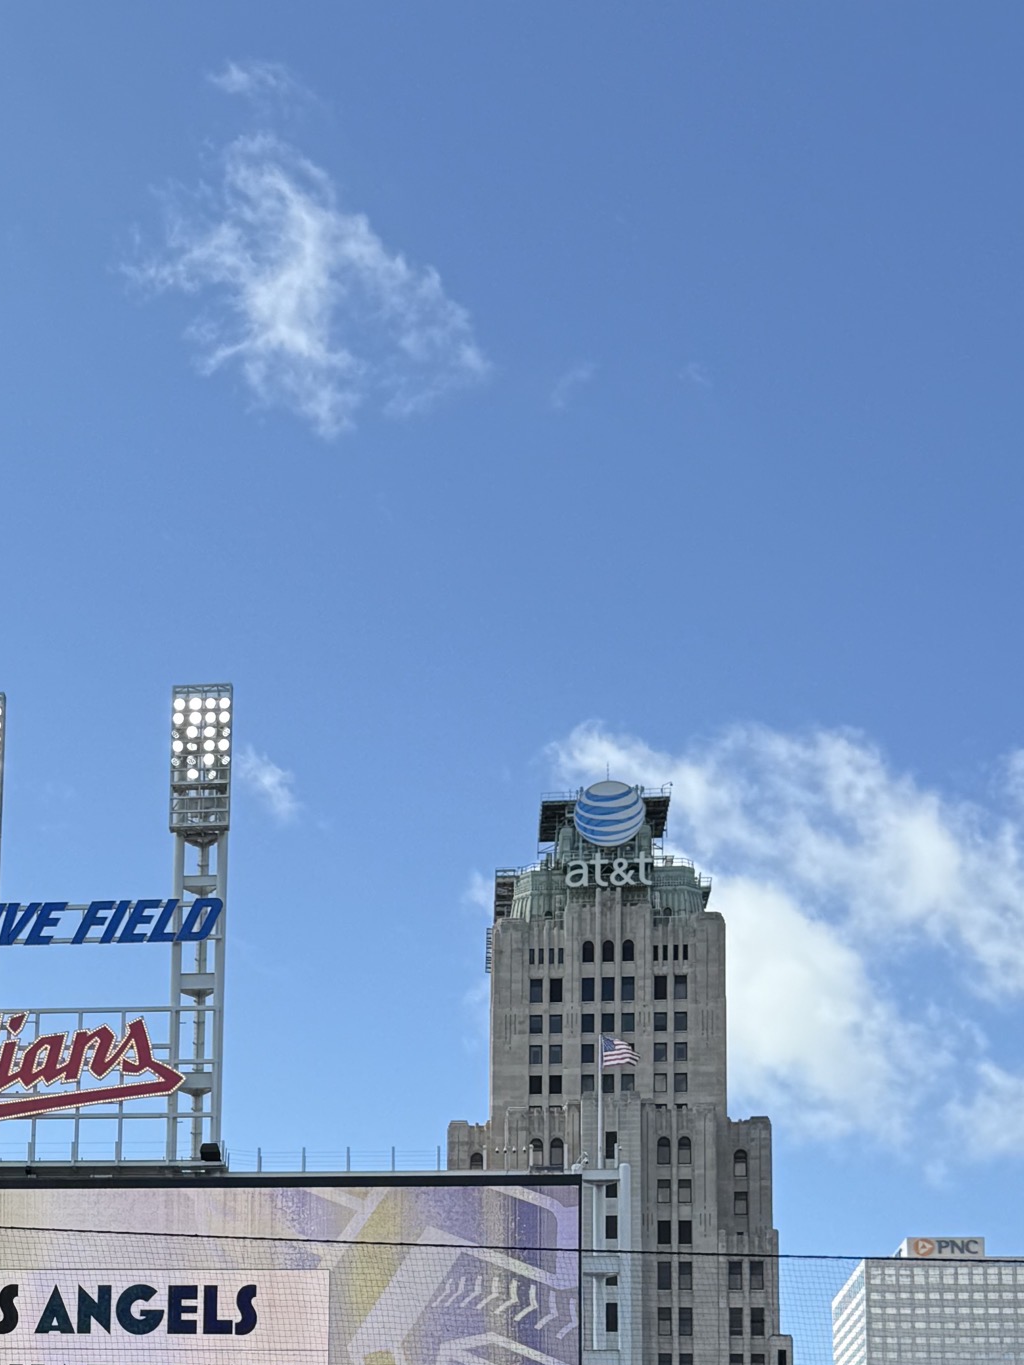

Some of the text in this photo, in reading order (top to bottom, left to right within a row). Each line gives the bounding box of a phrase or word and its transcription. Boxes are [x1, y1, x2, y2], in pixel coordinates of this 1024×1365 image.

[565, 855, 653, 888] at&t
[72, 897, 224, 945] FIELD
[936, 1239, 979, 1255] PNC
[35, 1284, 259, 1336] ANGELS
